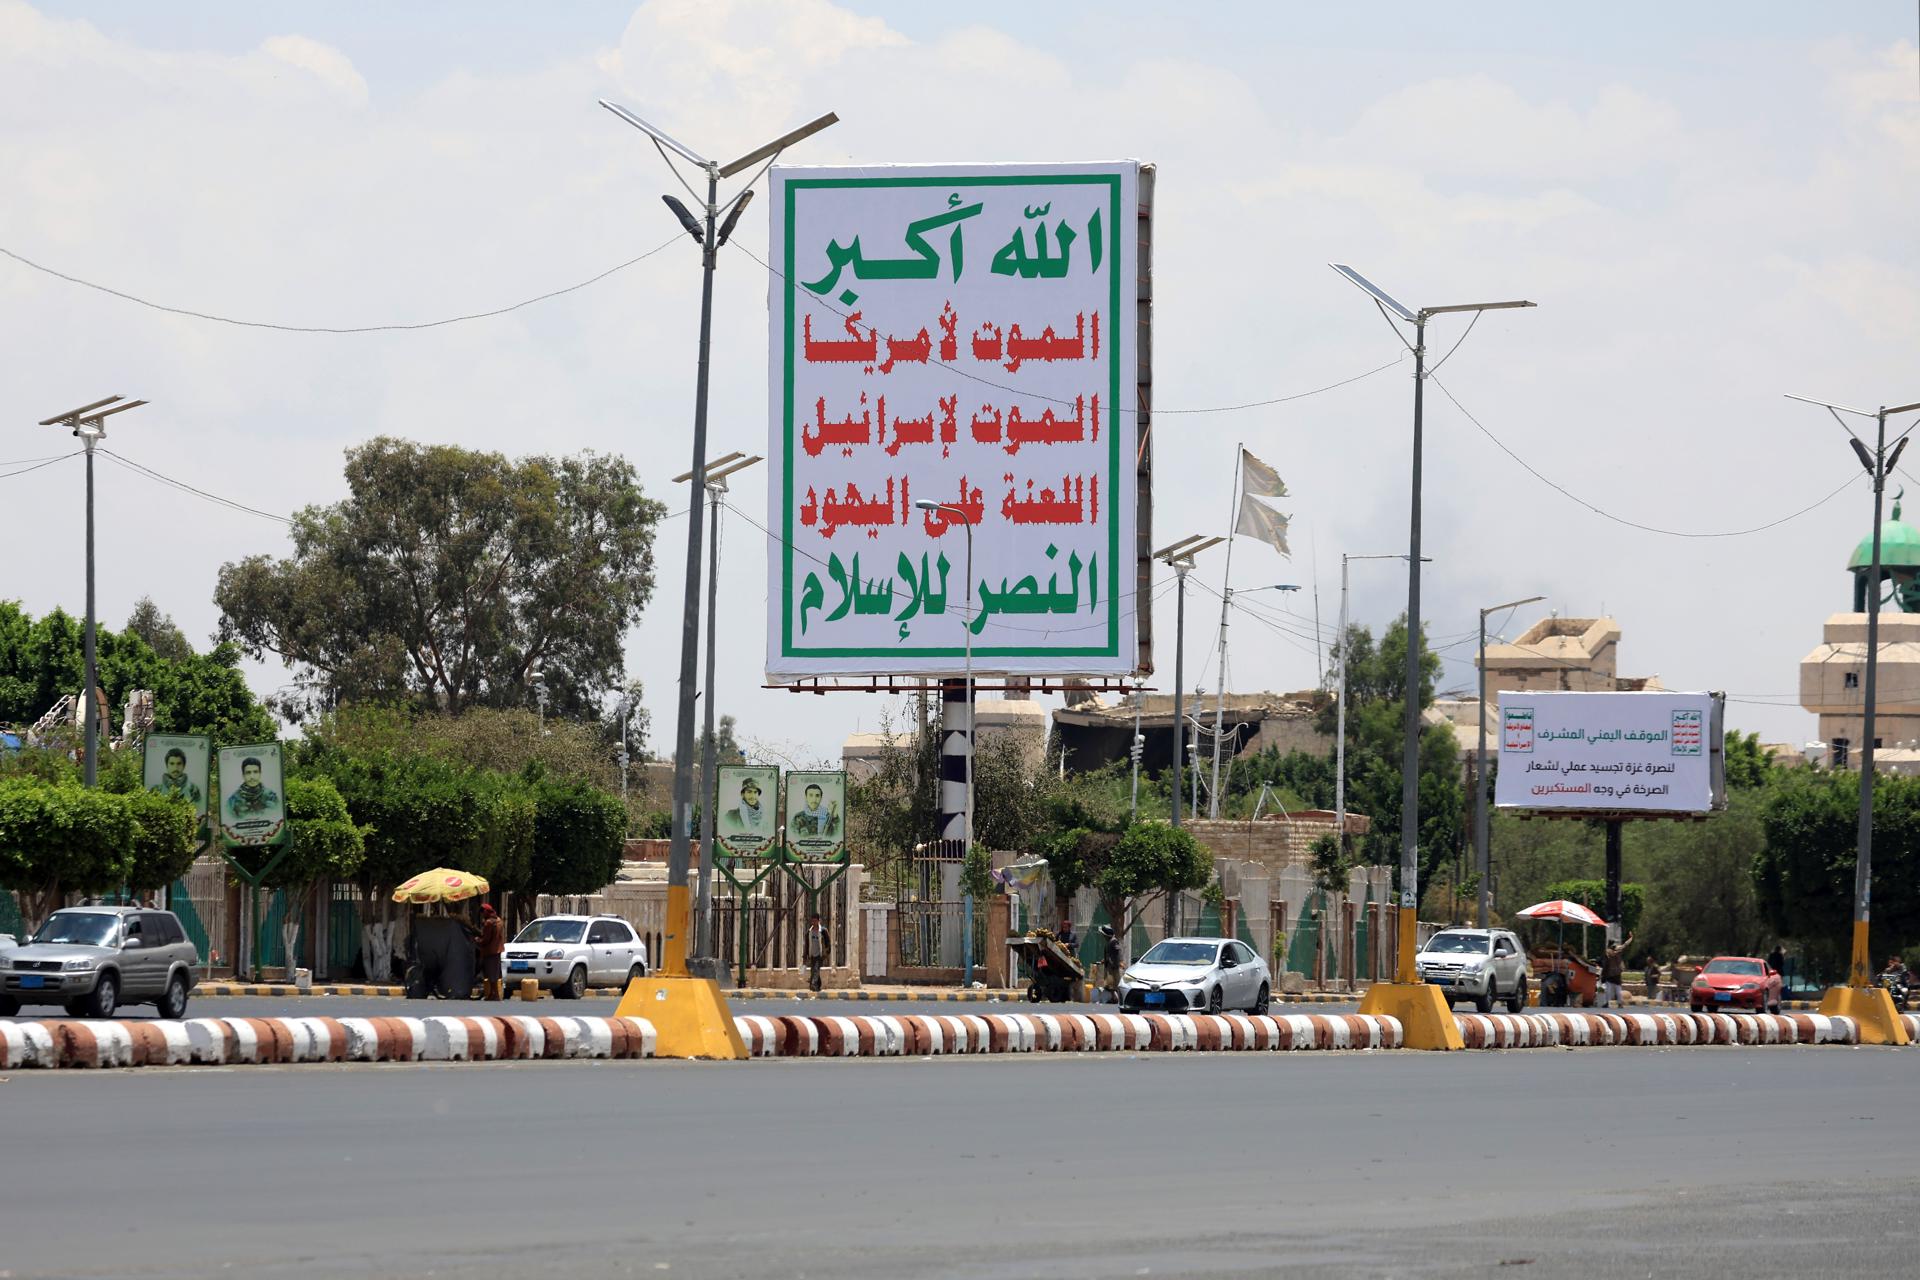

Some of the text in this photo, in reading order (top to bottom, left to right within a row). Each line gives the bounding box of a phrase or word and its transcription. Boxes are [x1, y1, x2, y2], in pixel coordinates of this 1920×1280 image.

[800, 193, 984, 306] أكبر
[804, 300, 1100, 375] الموت لأمريكا
[801, 391, 1100, 459] الموت لإسرائيل
[800, 472, 1099, 539] اللعنة على اليهود
[800, 543, 1099, 643] النصر للإسلام
[1525, 760, 1675, 776] لنصرة غزة تجسيد عملي لشعار
[1537, 728, 1668, 745] الموقف اليمني المشرف
[1531, 782, 1669, 799] الصرخة في وجه المستكبرين
